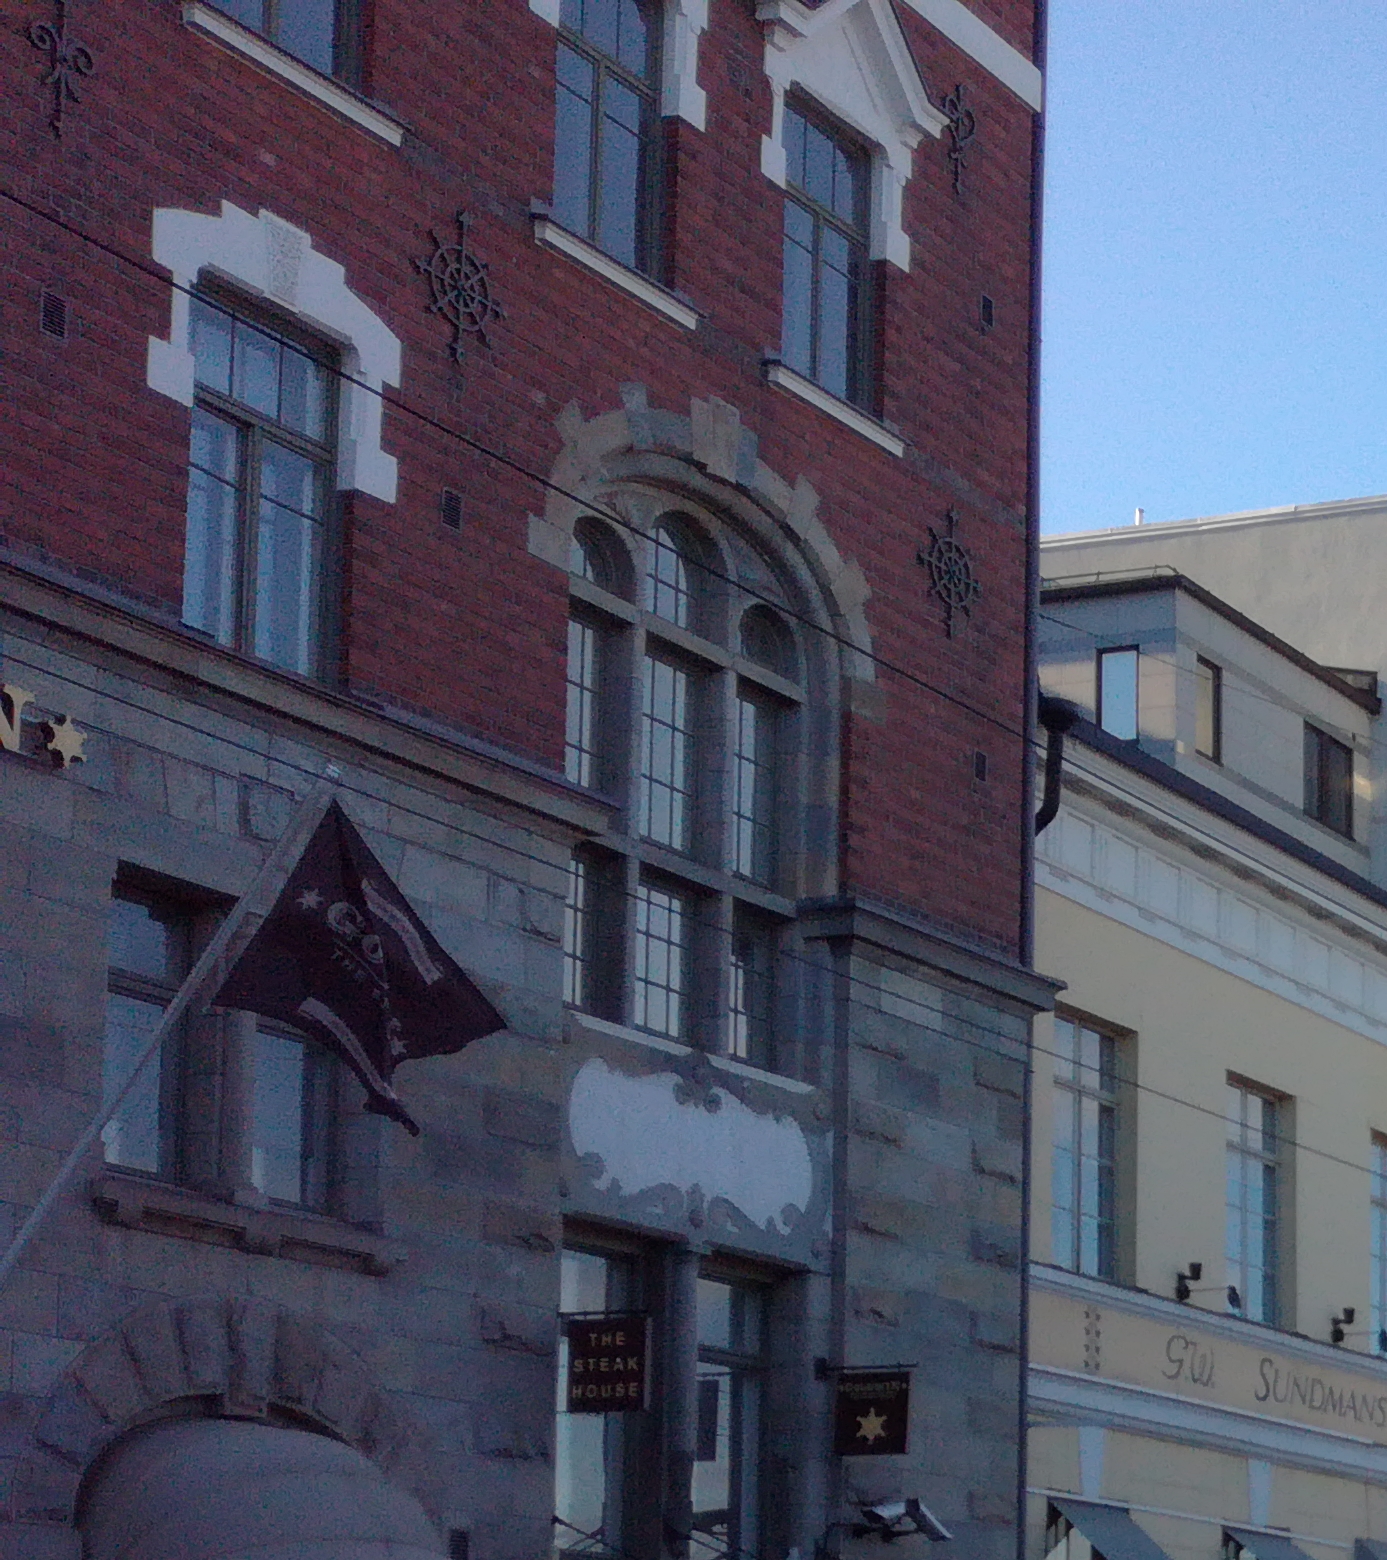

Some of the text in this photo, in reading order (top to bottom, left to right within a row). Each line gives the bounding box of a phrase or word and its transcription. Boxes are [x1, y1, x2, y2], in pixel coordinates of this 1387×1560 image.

[588, 1331, 626, 1347] THE
[573, 1356, 639, 1373] STEAK
[572, 1381, 639, 1399] HOUSE
[1254, 1358, 1387, 1427] SUNDMANS
